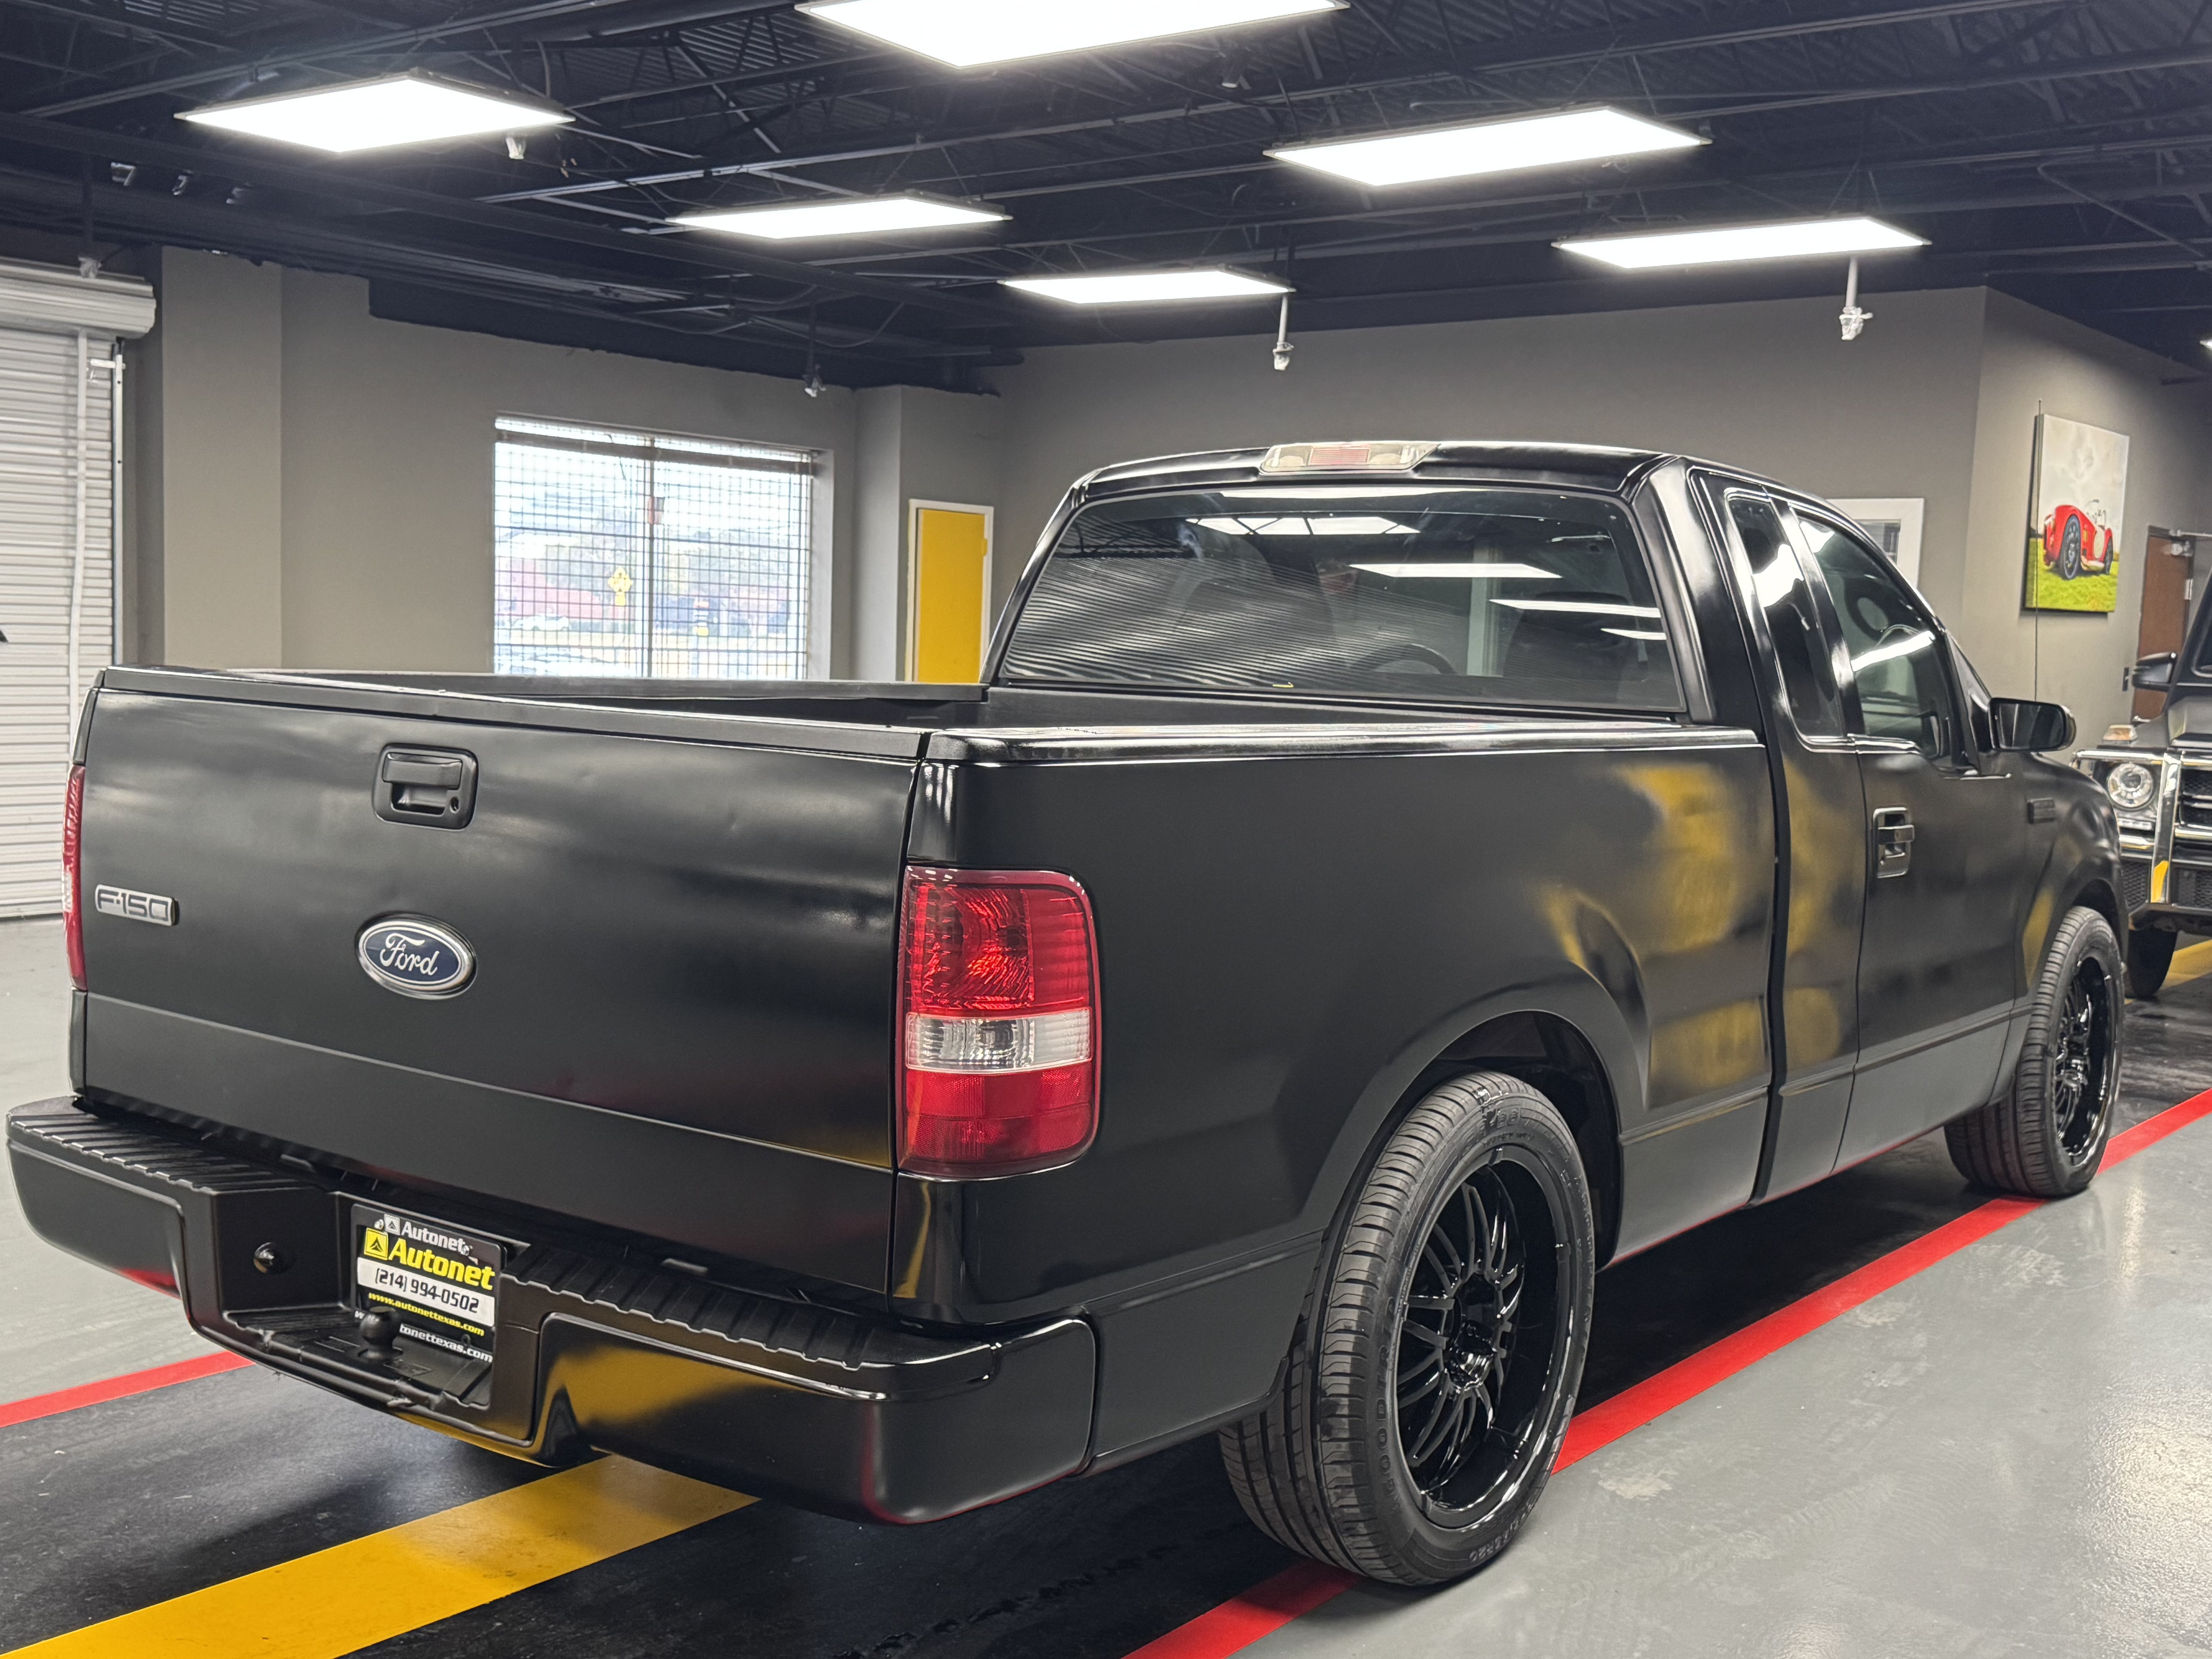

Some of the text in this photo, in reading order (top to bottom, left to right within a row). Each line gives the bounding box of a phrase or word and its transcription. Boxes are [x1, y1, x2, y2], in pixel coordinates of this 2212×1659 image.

[380, 933, 440, 975] Ford
[401, 1221, 465, 1253] Autonet
[389, 1238, 495, 1290] Autonet
[375, 1268, 479, 1314] (214) 994-0502
[369, 1292, 484, 1336] www.autonettexas.com
